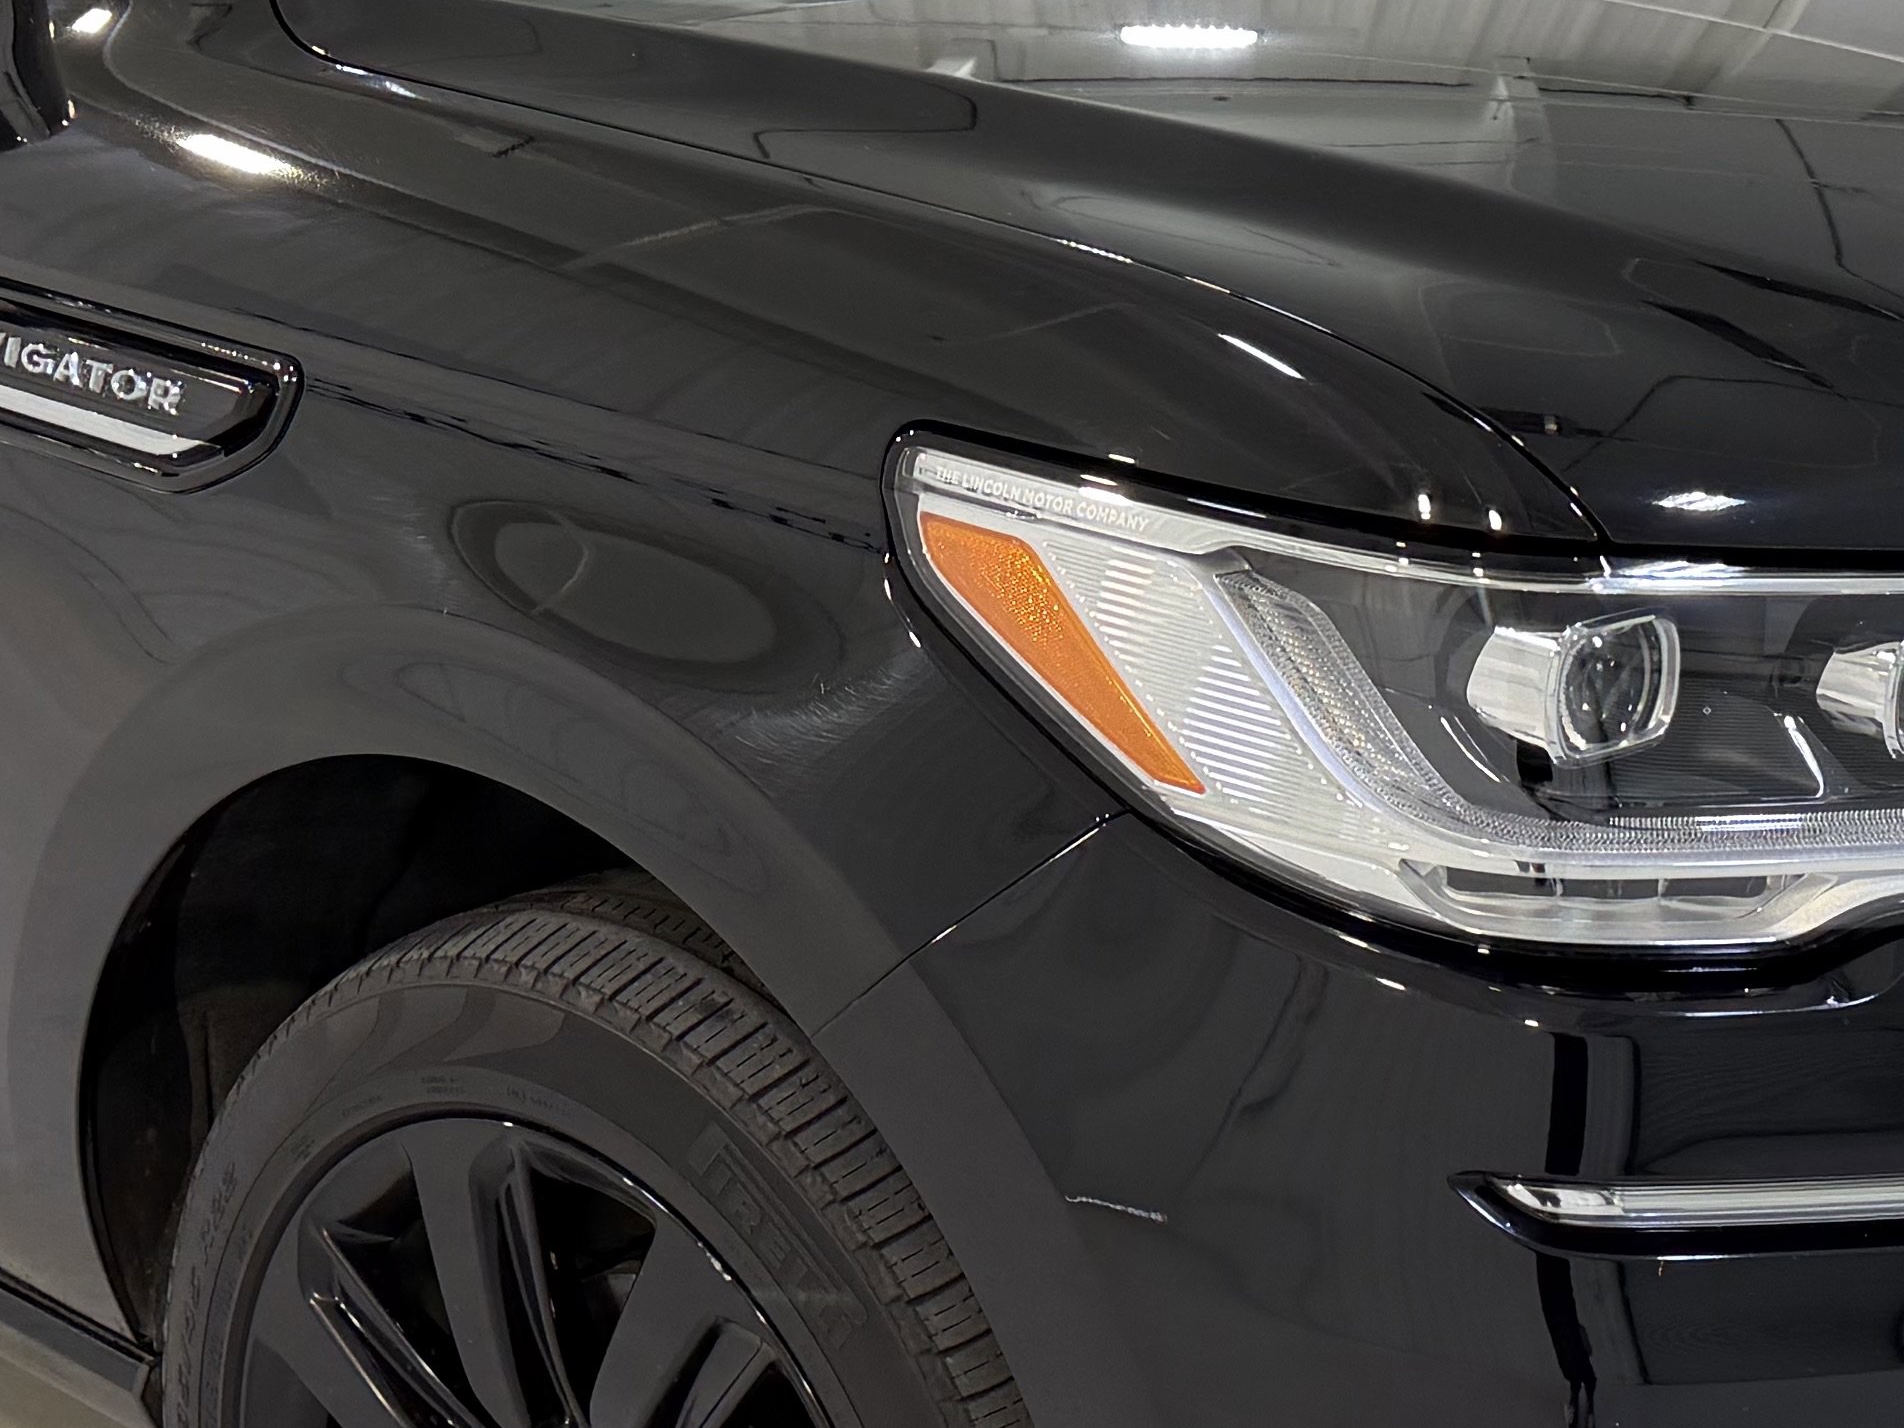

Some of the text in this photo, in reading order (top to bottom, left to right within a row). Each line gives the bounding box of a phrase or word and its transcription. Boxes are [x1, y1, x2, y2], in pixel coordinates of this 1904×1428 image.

[936, 467, 1150, 532] THE LINCOLN MOTOR COMPANY
